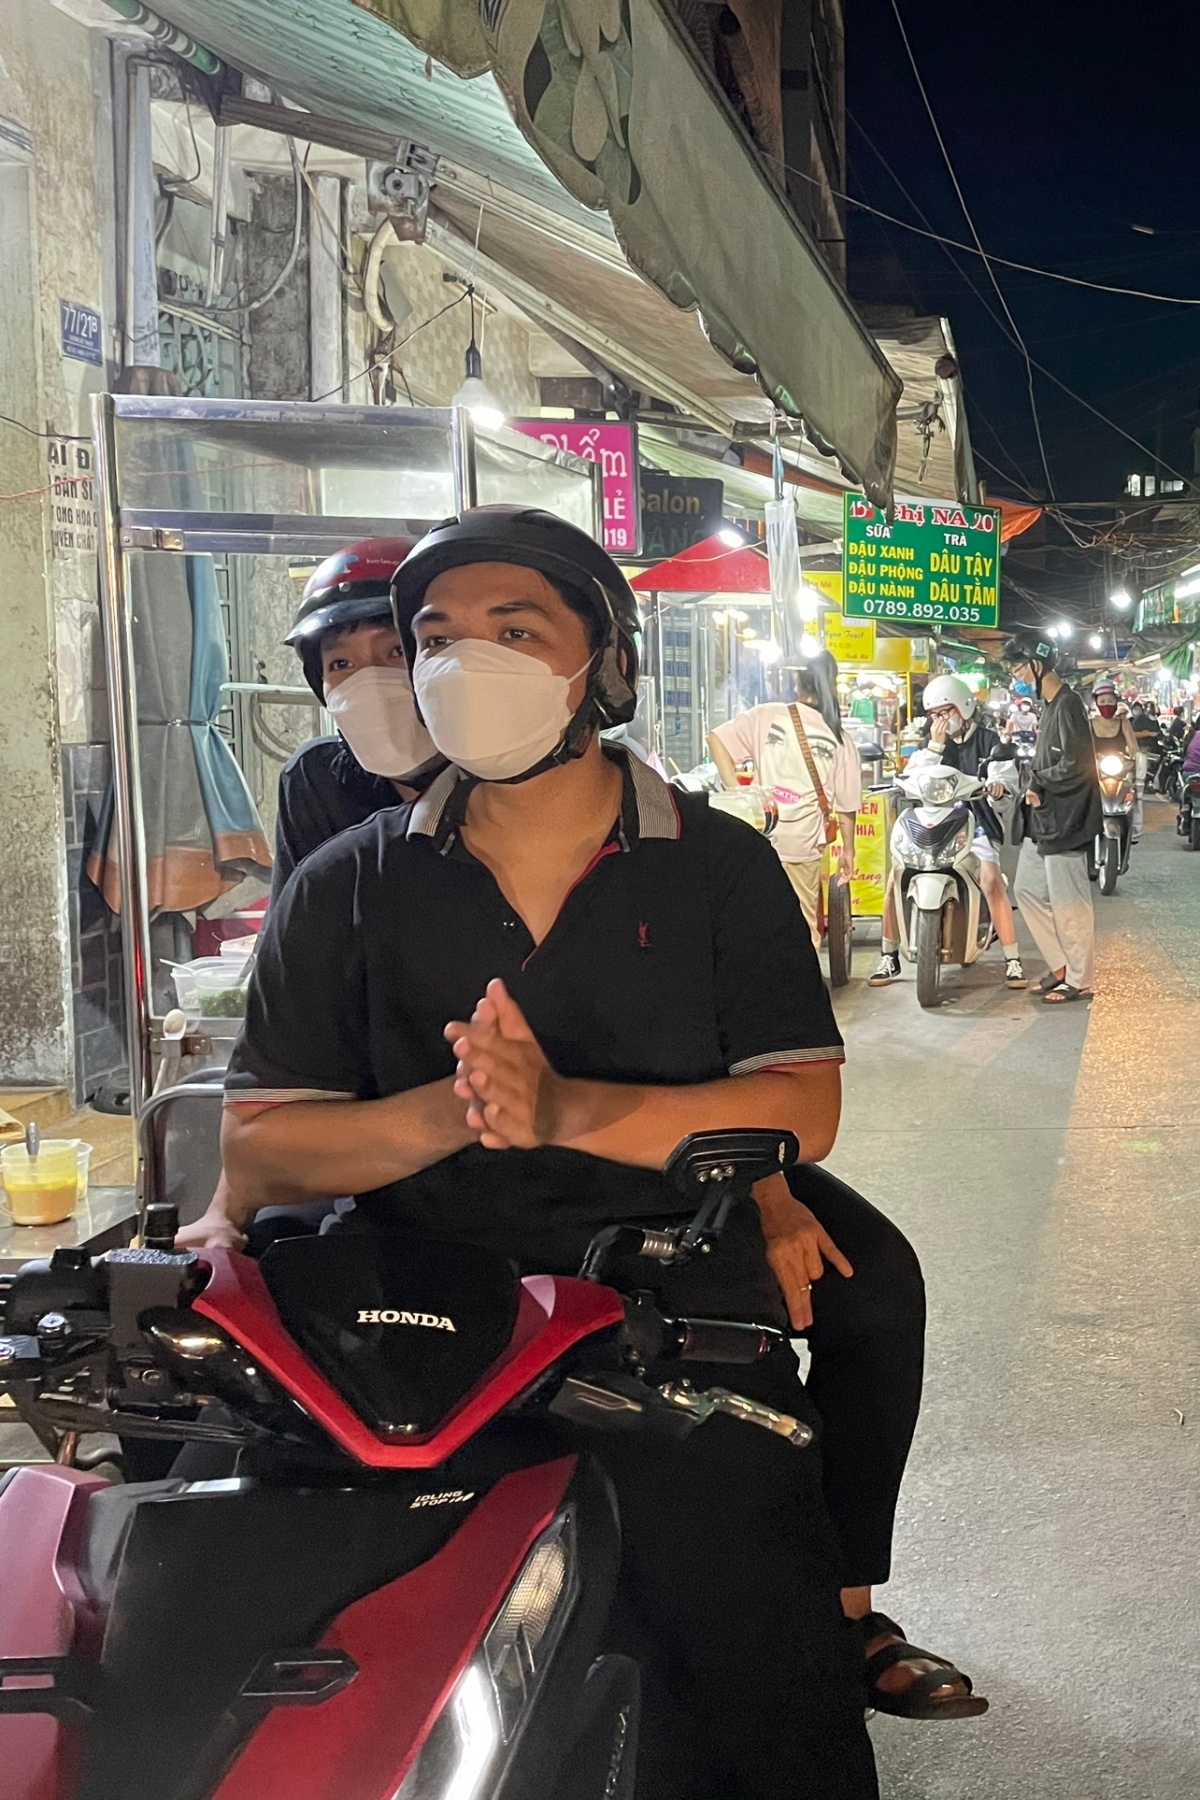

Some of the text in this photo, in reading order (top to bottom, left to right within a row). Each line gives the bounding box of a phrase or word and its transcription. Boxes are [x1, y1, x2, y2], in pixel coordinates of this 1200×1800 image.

[931, 507, 969, 528] NA
[51, 528, 75, 549] UYÊN
[943, 532, 967, 547] TRÀ
[848, 541, 915, 561] ĐẬU XANH
[848, 560, 924, 581] ĐẬU PHỘNG
[929, 548, 993, 577] DÂU TÂY
[848, 579, 915, 598] ĐẬU NÀNH
[929, 577, 995, 606] DÂU TẰM
[863, 598, 980, 622] 0789.892.035
[856, 824, 875, 836] HIA
[357, 1310, 456, 1332] HONDA
[409, 1498, 449, 1509] STOP
[414, 1490, 463, 1503] IDLING
